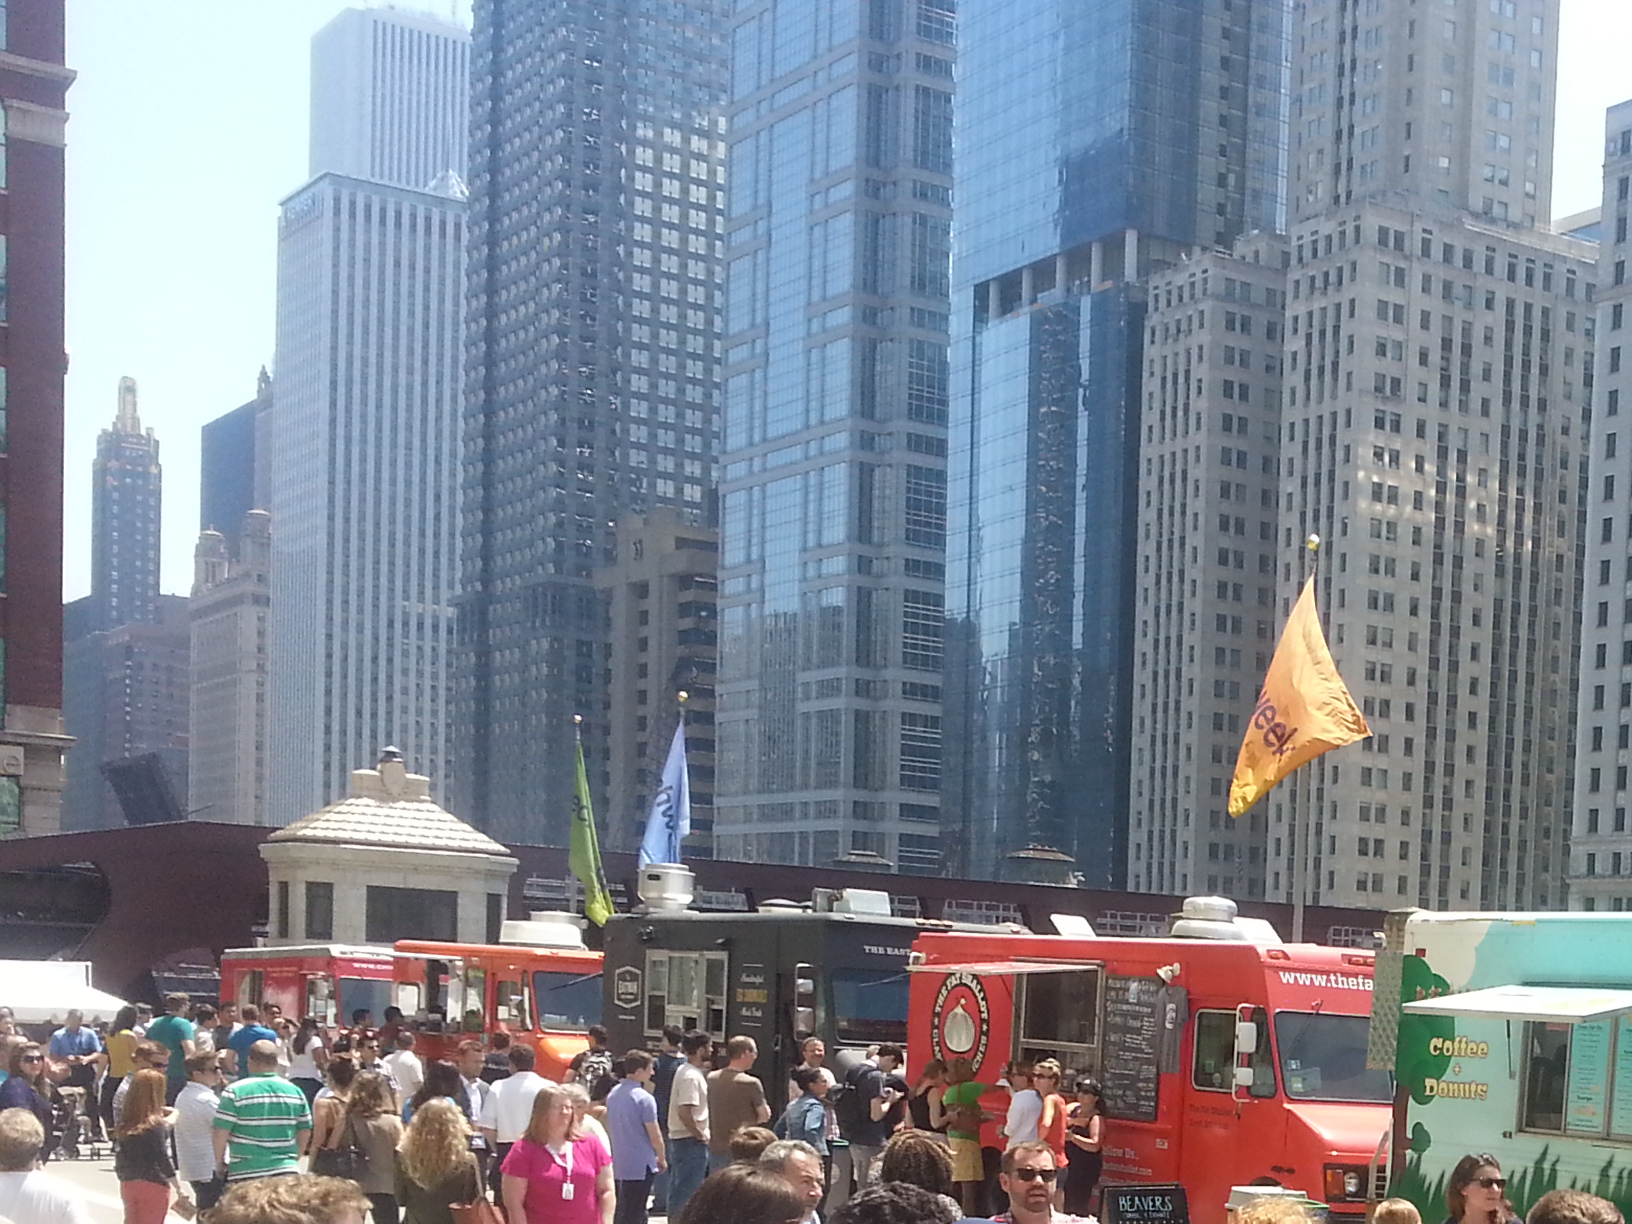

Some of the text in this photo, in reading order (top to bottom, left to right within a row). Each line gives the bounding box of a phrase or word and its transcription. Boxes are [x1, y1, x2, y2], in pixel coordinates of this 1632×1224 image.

[864, 945, 885, 954] THE
[1279, 970, 1374, 992] www.thefa
[1429, 1036, 1489, 1059] Coffee
[1424, 1077, 1488, 1101] Donuts
[1119, 1195, 1173, 1213] BEAVERS
